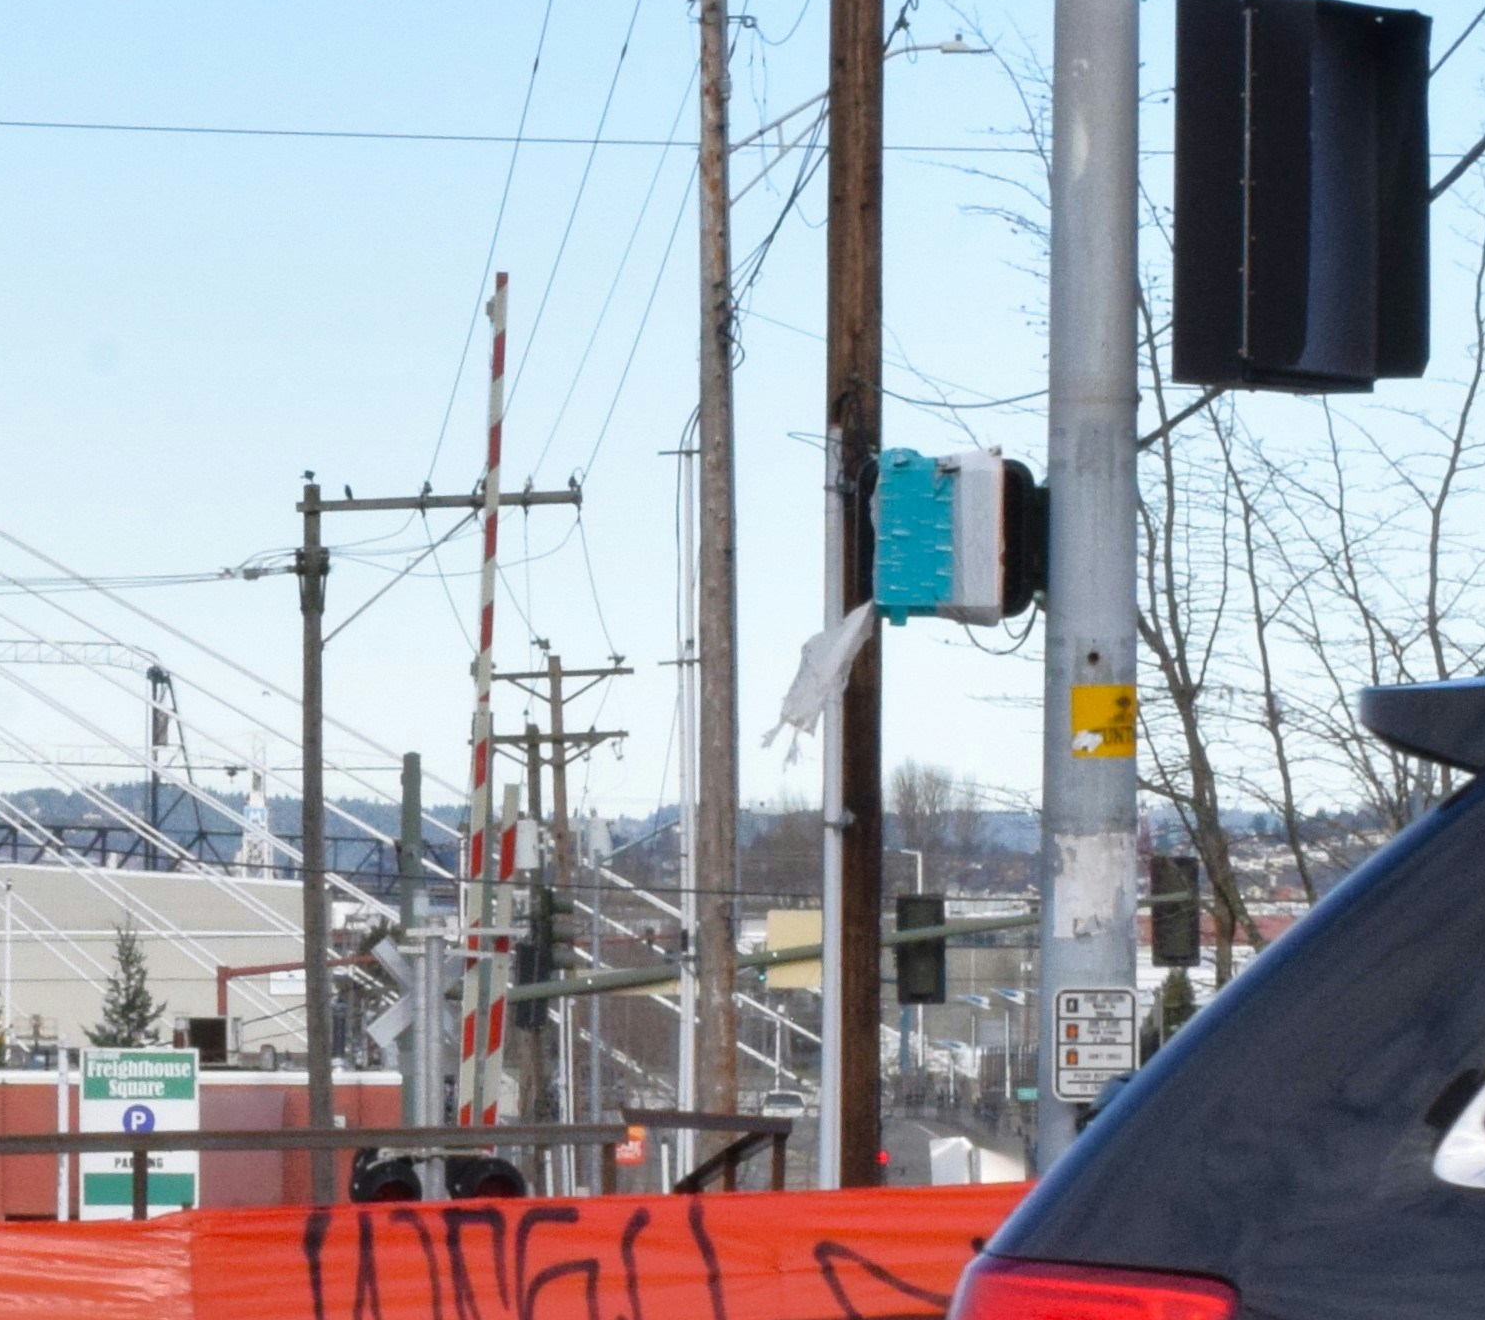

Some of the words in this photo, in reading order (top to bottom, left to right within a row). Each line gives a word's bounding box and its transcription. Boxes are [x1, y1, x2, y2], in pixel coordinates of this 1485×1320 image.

[88, 1060, 191, 1078] Freighthouse
[109, 1081, 164, 1098] Square
[130, 1110, 147, 1131] P
[115, 1158, 163, 1168] PARNG
